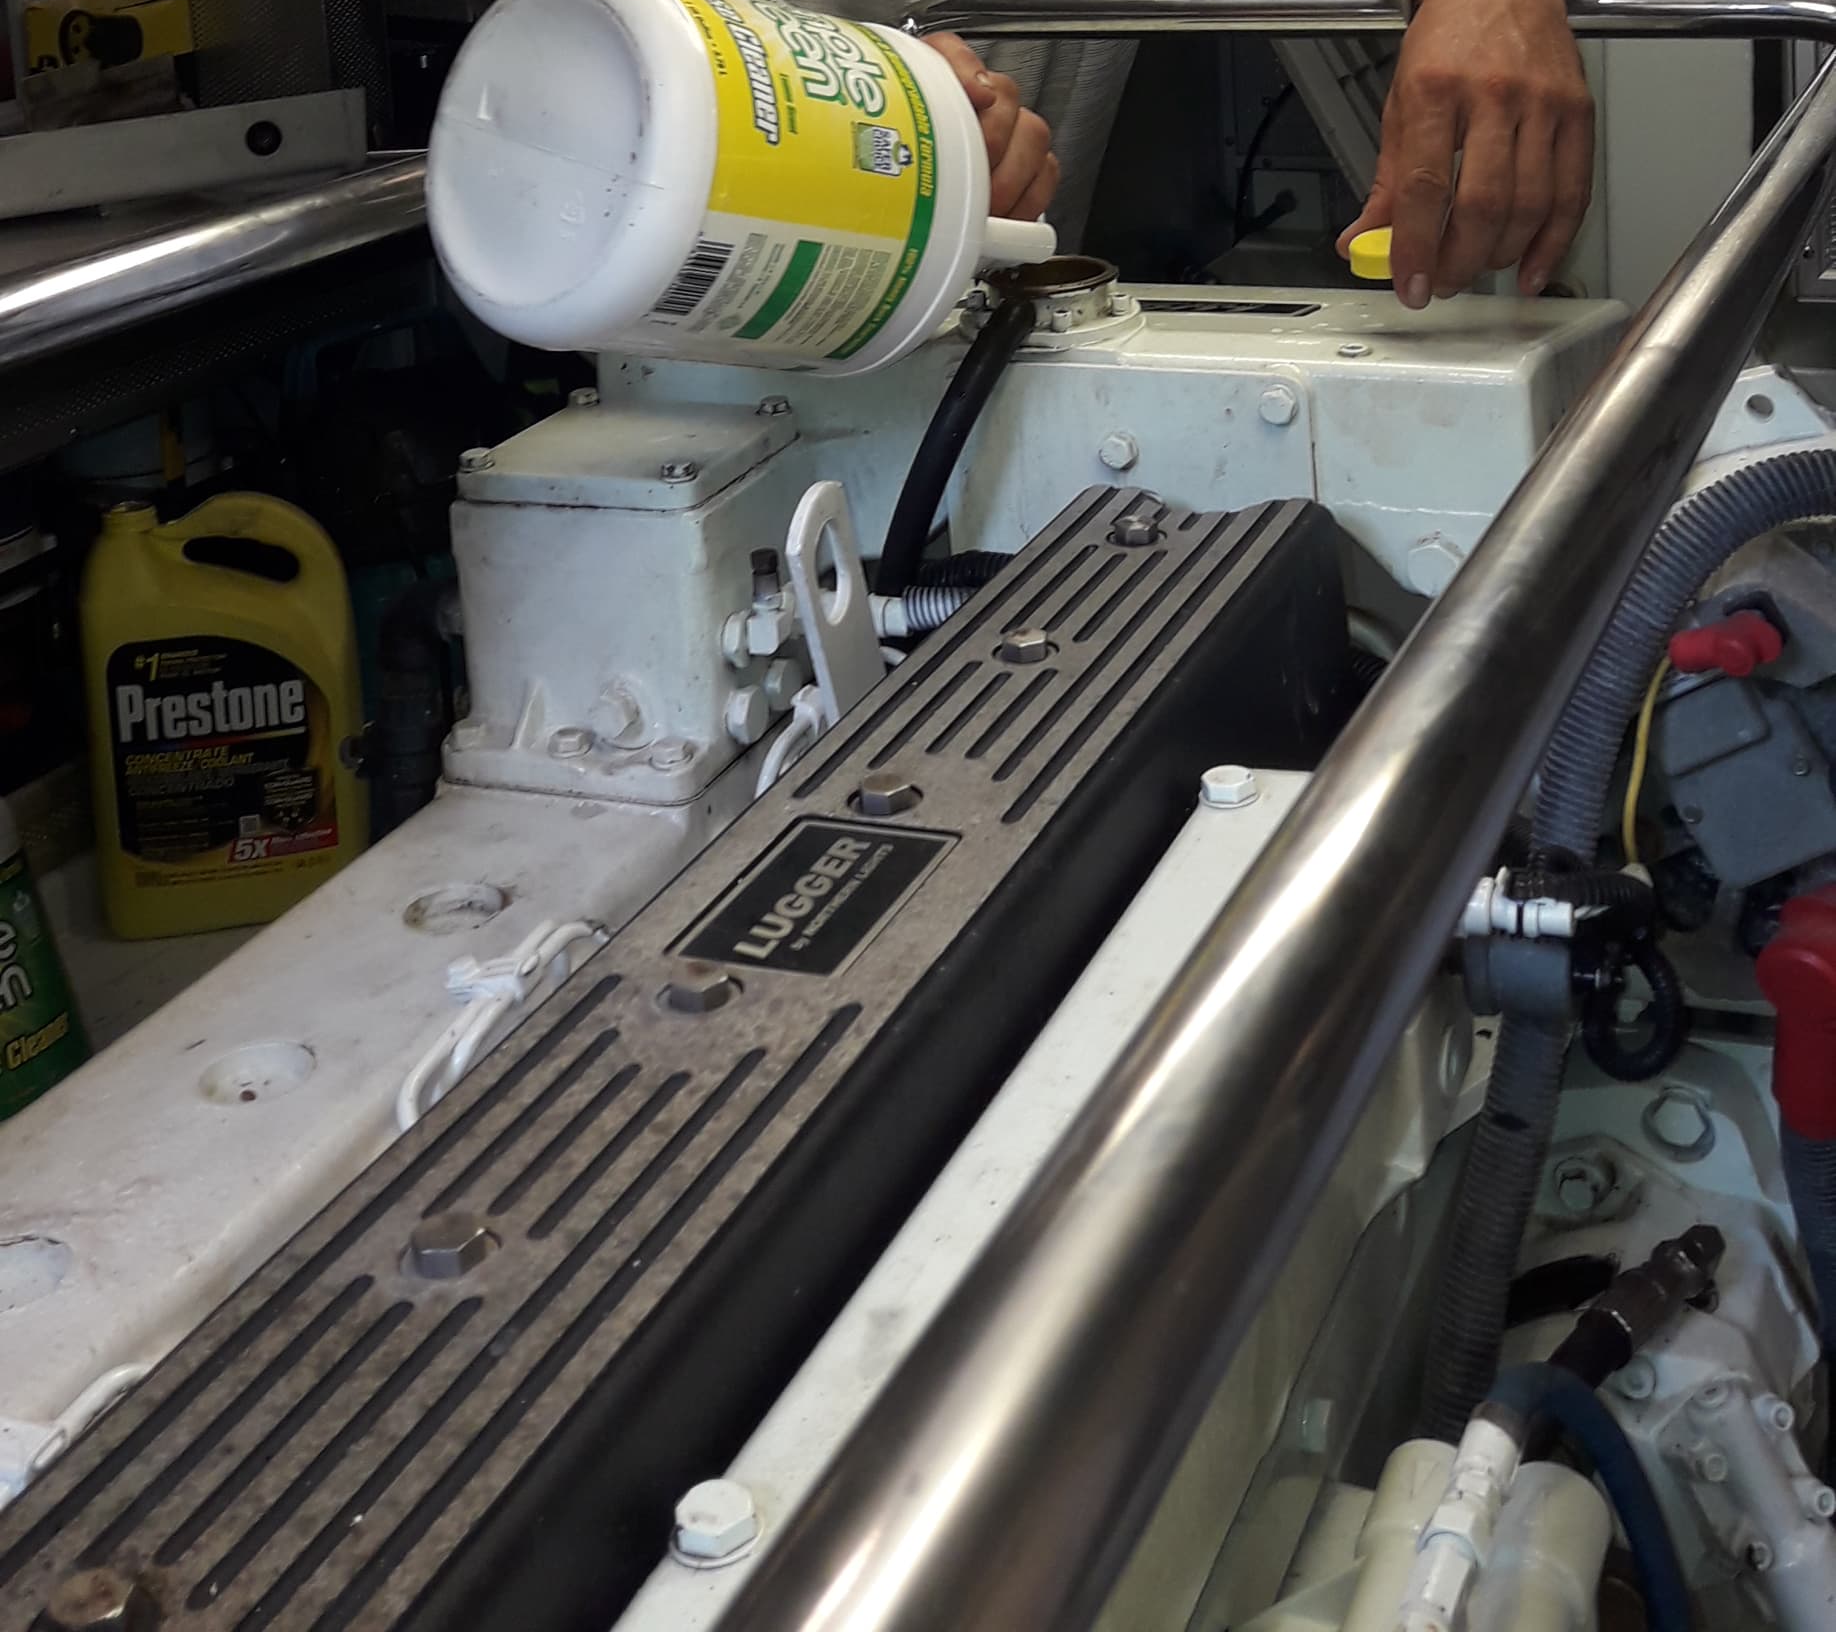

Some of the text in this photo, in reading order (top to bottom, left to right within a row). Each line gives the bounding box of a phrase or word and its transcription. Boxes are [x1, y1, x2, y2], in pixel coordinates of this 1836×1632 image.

[729, 22, 780, 146] Cleaner
[919, 136, 934, 197] Formula
[115, 679, 307, 744] Prestone
[125, 746, 231, 766] CONCENTRATE
[733, 837, 872, 960] LUGGER
